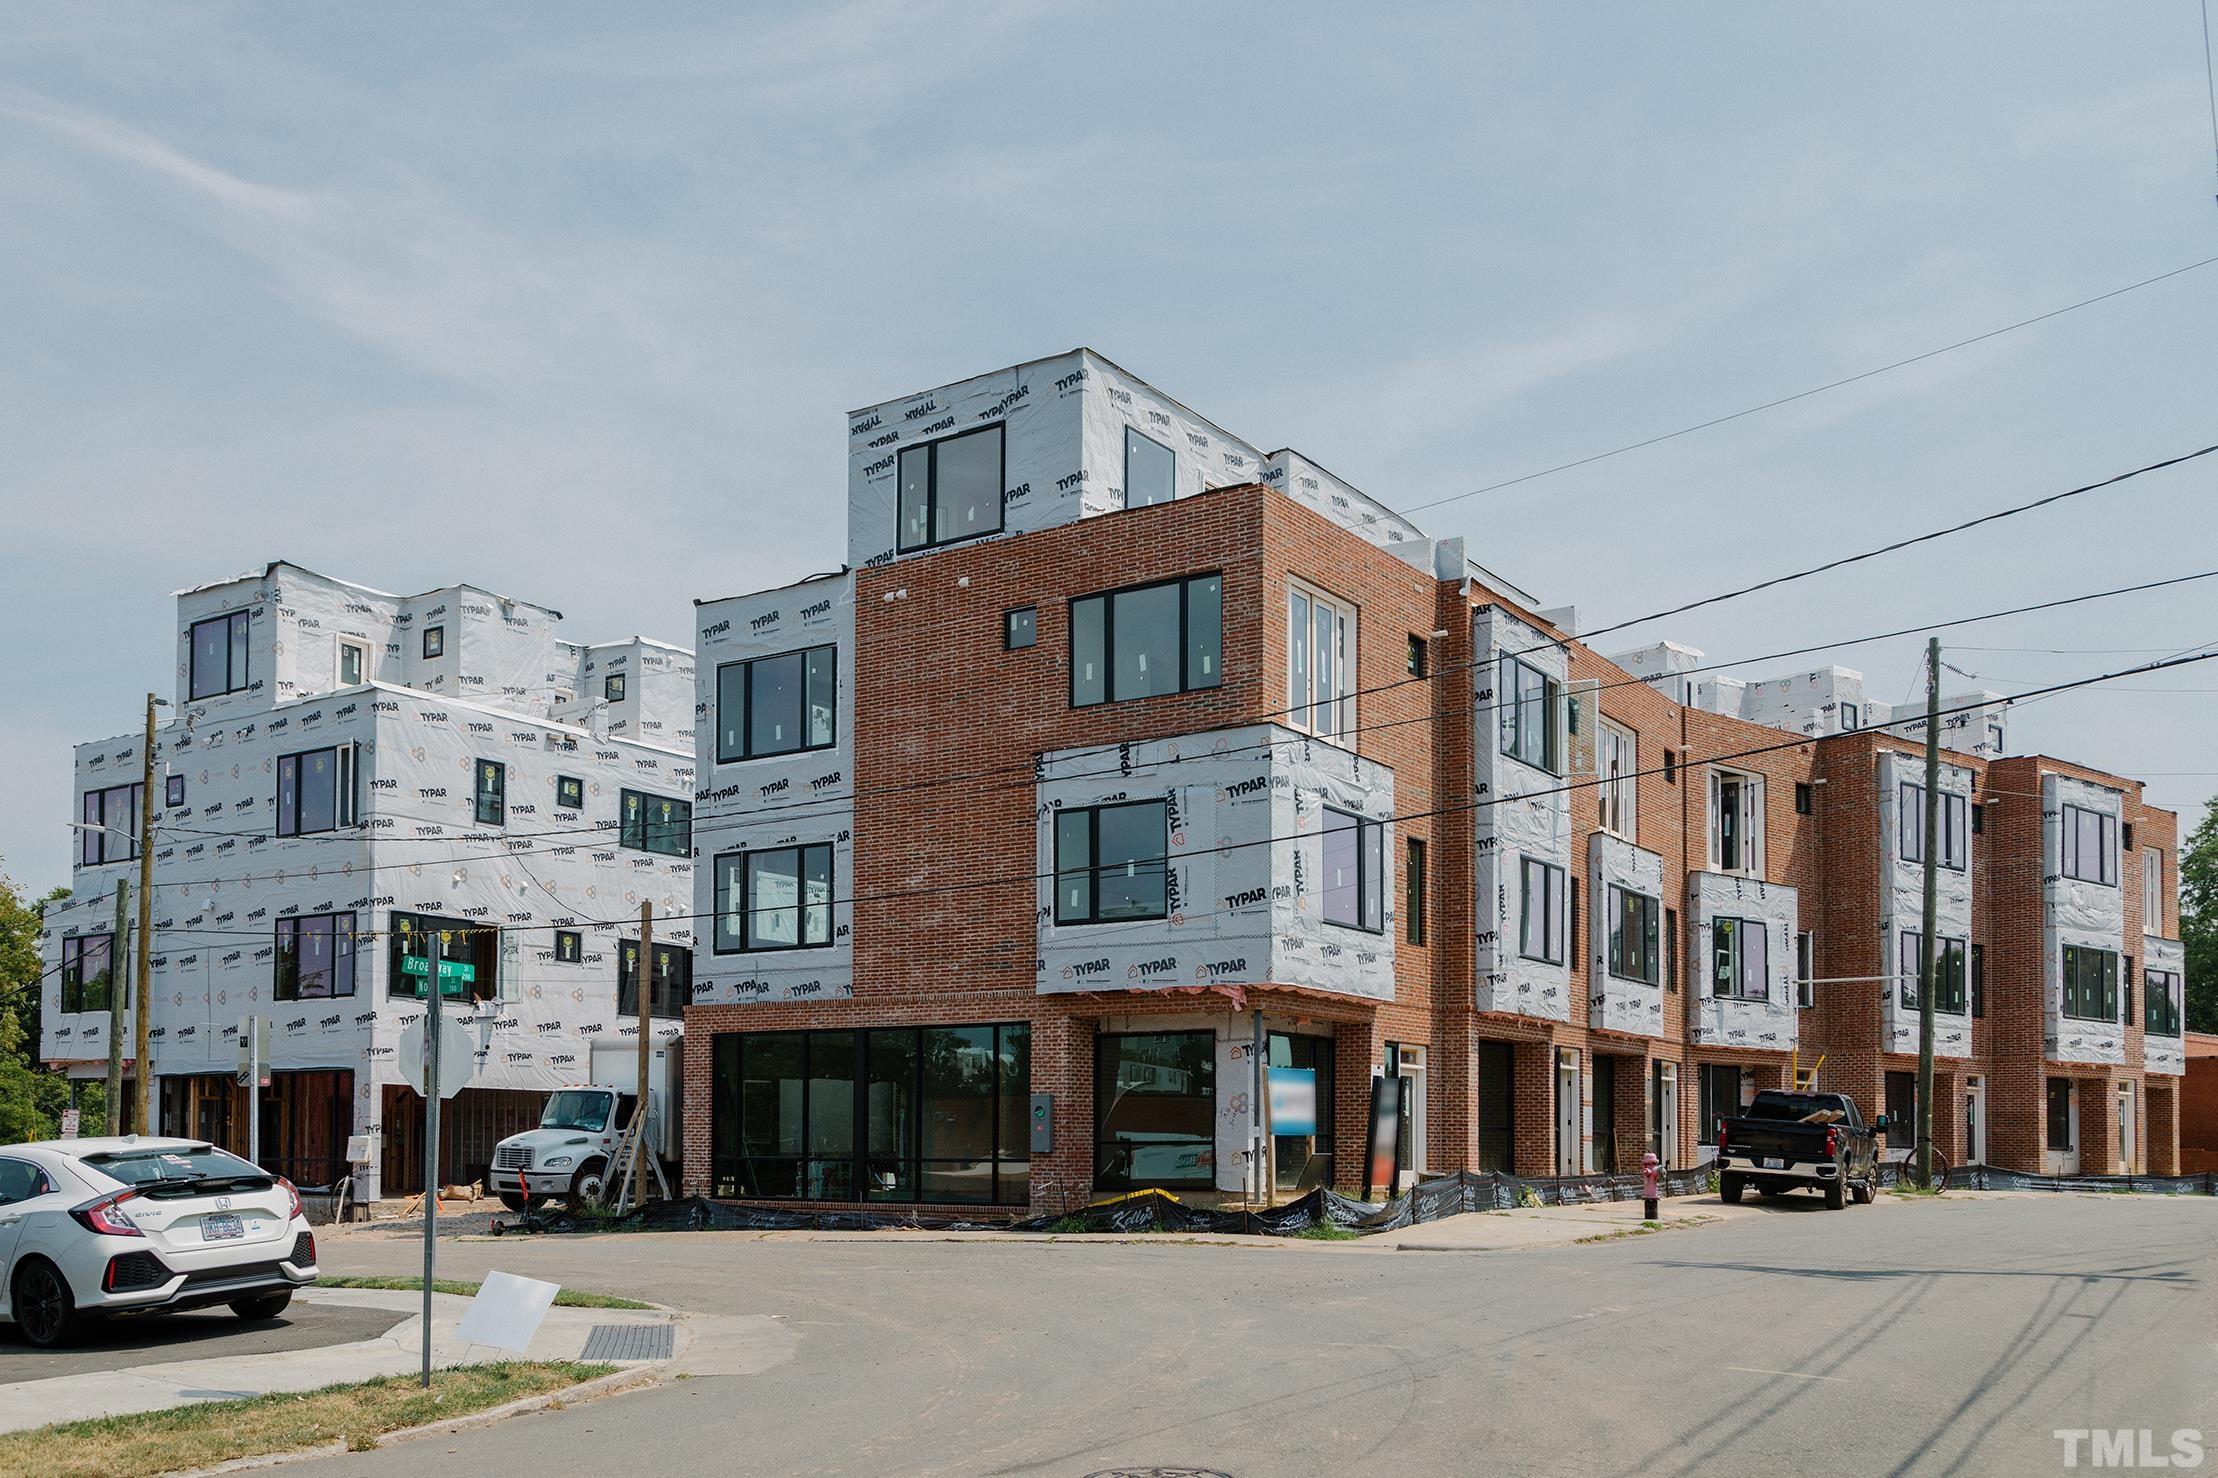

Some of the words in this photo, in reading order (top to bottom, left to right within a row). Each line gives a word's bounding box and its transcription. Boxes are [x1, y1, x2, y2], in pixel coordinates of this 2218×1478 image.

[1055, 368, 1090, 392] TYPAR
[1108, 387, 1131, 404] TYPAR
[921, 415, 955, 435] TYPAR
[1148, 411, 1171, 426] TYPAR
[867, 430, 899, 449] TYPAR
[1187, 432, 1209, 448] TYPAR
[863, 454, 895, 477] TYPAR
[1056, 469, 1089, 491] TYPAR
[1300, 477, 1319, 491] TYPAR
[426, 604, 446, 621] TYPAR
[460, 604, 486, 615] TYPAR
[800, 600, 831, 620] TYPAR
[505, 618, 528, 627] TYPAR
[750, 610, 780, 630] TYPAR
[702, 620, 730, 640] TYPAR
[607, 655, 627, 669] TYPAR
[642, 656, 664, 665] TYPAR
[458, 675, 484, 685] TYPAR
[335, 703, 357, 719] TYPAR
[371, 702, 399, 712] TYPAR
[301, 710, 322, 726] TYPAR
[420, 713, 448, 722] TYPAR
[268, 718, 288, 733] TYPAR
[468, 723, 493, 732] TYPAR
[641, 721, 662, 730] TYPAR
[512, 733, 536, 742] TYPAR
[555, 743, 579, 752] TYPAR
[116, 748, 133, 762] TYPAR
[596, 751, 619, 760] TYPAR
[635, 760, 658, 769] TYPAR
[673, 768, 694, 777] TYPAR
[370, 780, 398, 789] TYPAR
[760, 778, 789, 798] TYPAR
[810, 771, 841, 791] TYPAR
[1225, 776, 1268, 799] TYPAR
[420, 789, 447, 798] TYPAR
[711, 784, 739, 803] TYPAR
[235, 797, 254, 811] TYPAR
[510, 805, 536, 815] TYPAR
[1168, 787, 1182, 834] TYPAR
[554, 813, 578, 822] TYPAR
[416, 826, 443, 836] TYPAR
[185, 843, 204, 858] TYPAR
[508, 840, 533, 850] TYPAR
[552, 847, 575, 856] TYPAR
[592, 853, 615, 862] TYPAR
[631, 859, 654, 868] TYPAR
[670, 865, 692, 873] TYPAR
[1168, 866, 1181, 913] TYPAR
[1225, 886, 1267, 909] TYPAR
[415, 901, 443, 911] TYPAR
[462, 906, 489, 917] TYPAR
[215, 911, 234, 925] TYPAR
[247, 907, 266, 921] TYPAR
[507, 912, 532, 922] TYPAR
[593, 922, 615, 931] TYPAR
[670, 930, 691, 939] TYPAR
[1280, 938, 1304, 952] TYPAR
[1320, 945, 1342, 958] TYPAR
[253, 946, 273, 961] TYPAR
[407, 957, 452, 977] Broaay
[1073, 959, 1110, 977] TYPAR
[1138, 957, 1177, 976] TYPAR
[1206, 958, 1247, 977] TYPAR
[791, 979, 821, 997] TYPAR
[286, 1017, 306, 1032] TYPAR
[320, 1014, 340, 1029] TYPAR
[354, 1011, 378, 1026] TYPAR
[493, 1018, 519, 1031] TYPAR
[537, 1021, 562, 1033] TYPAR
[579, 1023, 603, 1035] TYPAR
